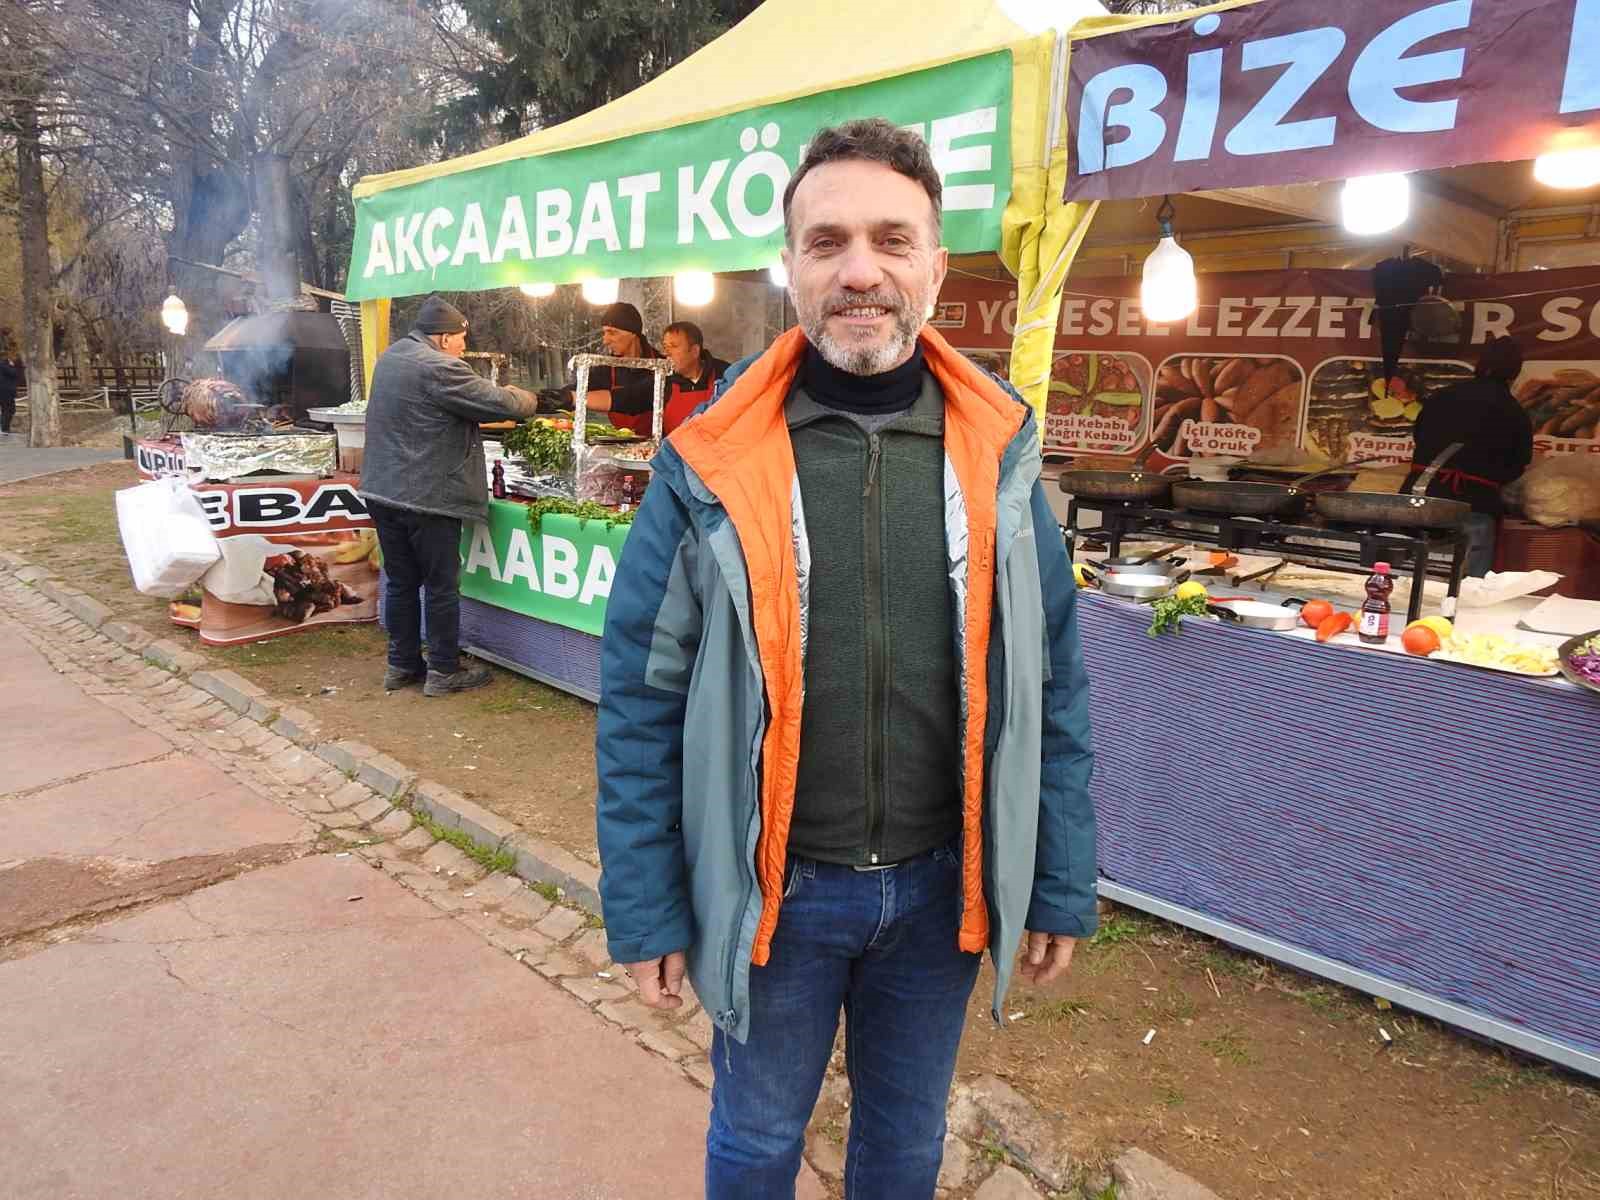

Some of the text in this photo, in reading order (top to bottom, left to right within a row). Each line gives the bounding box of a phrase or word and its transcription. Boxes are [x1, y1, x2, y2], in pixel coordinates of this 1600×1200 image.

[1078, 0, 1473, 175] BİZE
[363, 107, 998, 280] AKÇAABAT KÖE
[1185, 423, 1257, 440] İçli Köfte
[1207, 439, 1248, 451] Oruk
